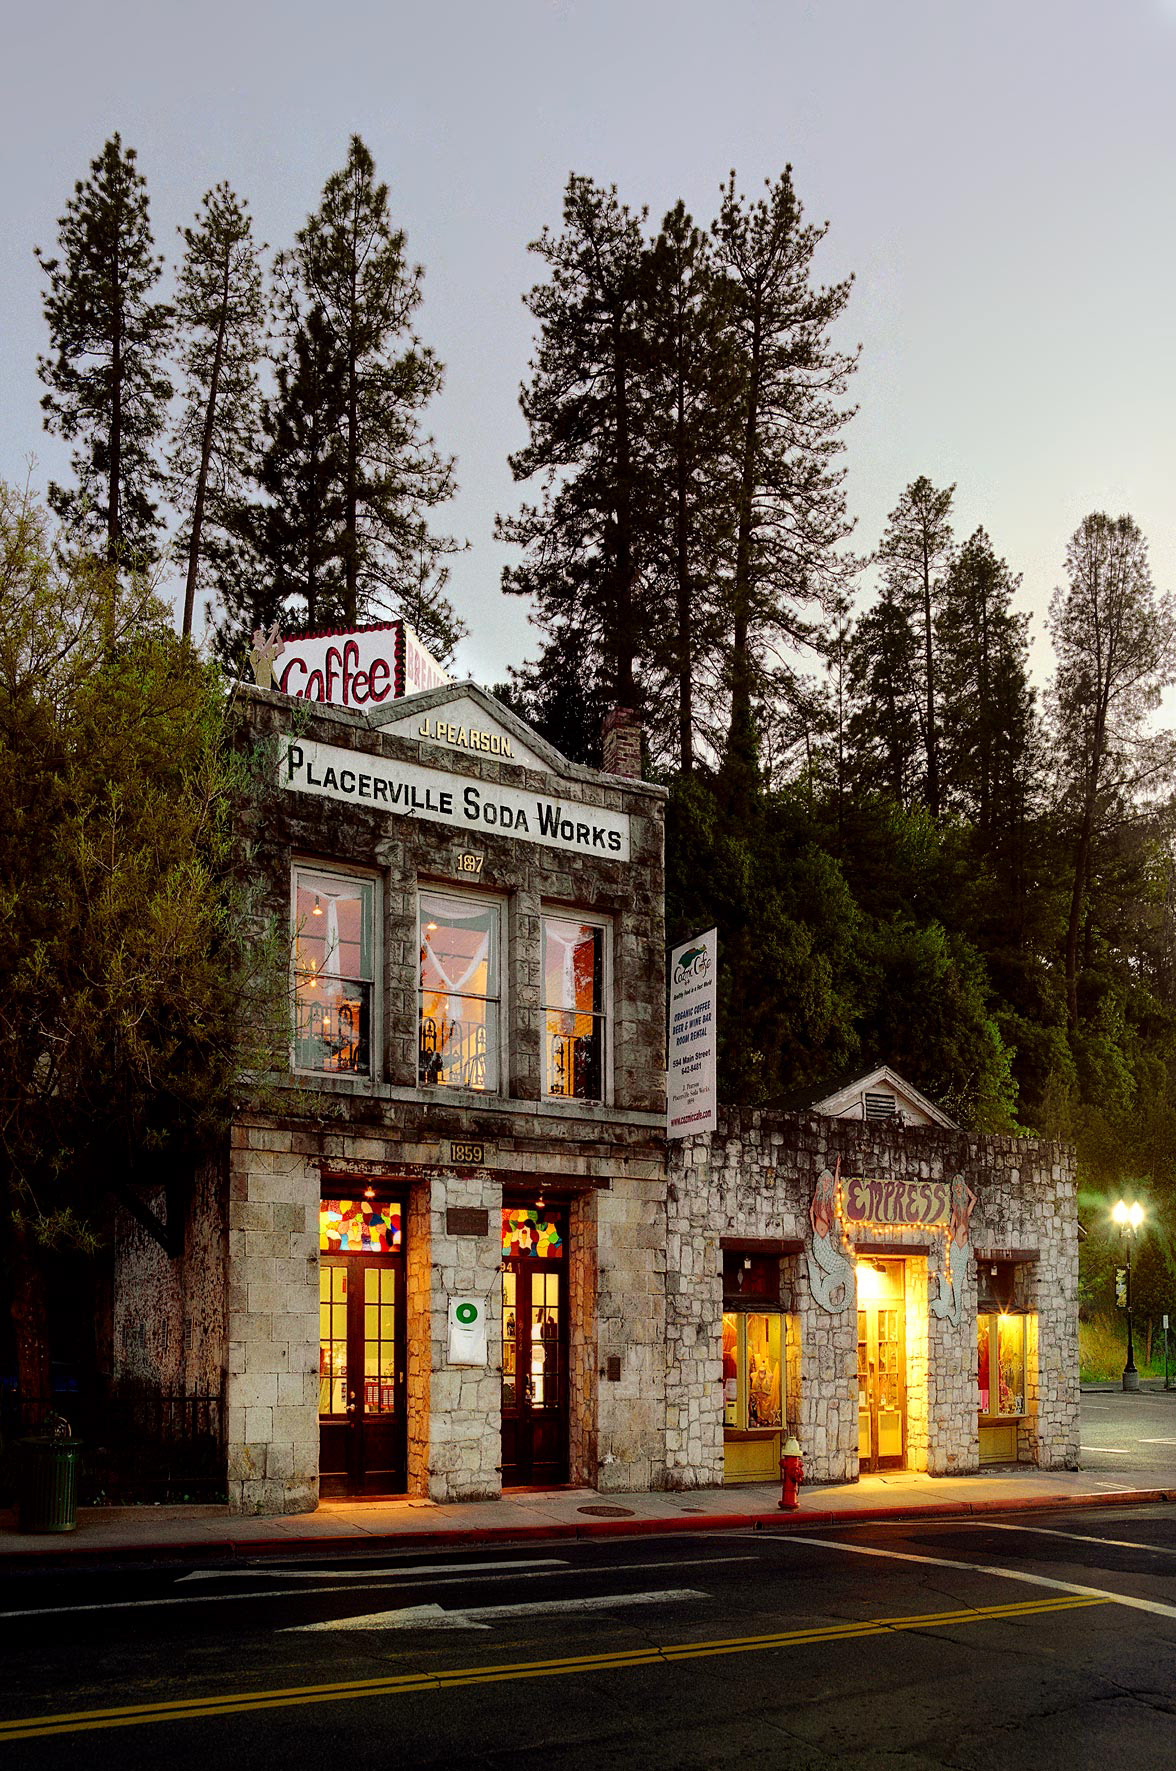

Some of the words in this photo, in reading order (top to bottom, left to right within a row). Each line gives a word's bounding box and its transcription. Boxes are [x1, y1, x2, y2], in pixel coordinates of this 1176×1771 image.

[279, 639, 392, 706] Coffee
[287, 744, 454, 816] PLACERVILLE
[463, 786, 530, 833] SODA
[536, 801, 622, 852] WORKS
[674, 1007, 694, 1022] ORGANIC
[694, 1000, 711, 1015] COFFEE
[672, 1022, 684, 1036] BEER
[689, 1016, 702, 1029] WINE
[702, 1012, 712, 1024] BAR
[676, 1033, 690, 1047] ROOM
[690, 1026, 707, 1041] RENTAL
[683, 1055, 694, 1064] Main
[695, 1049, 710, 1060] Street
[451, 1143, 483, 1163] 1859
[847, 1179, 947, 1223] EMPRESS
